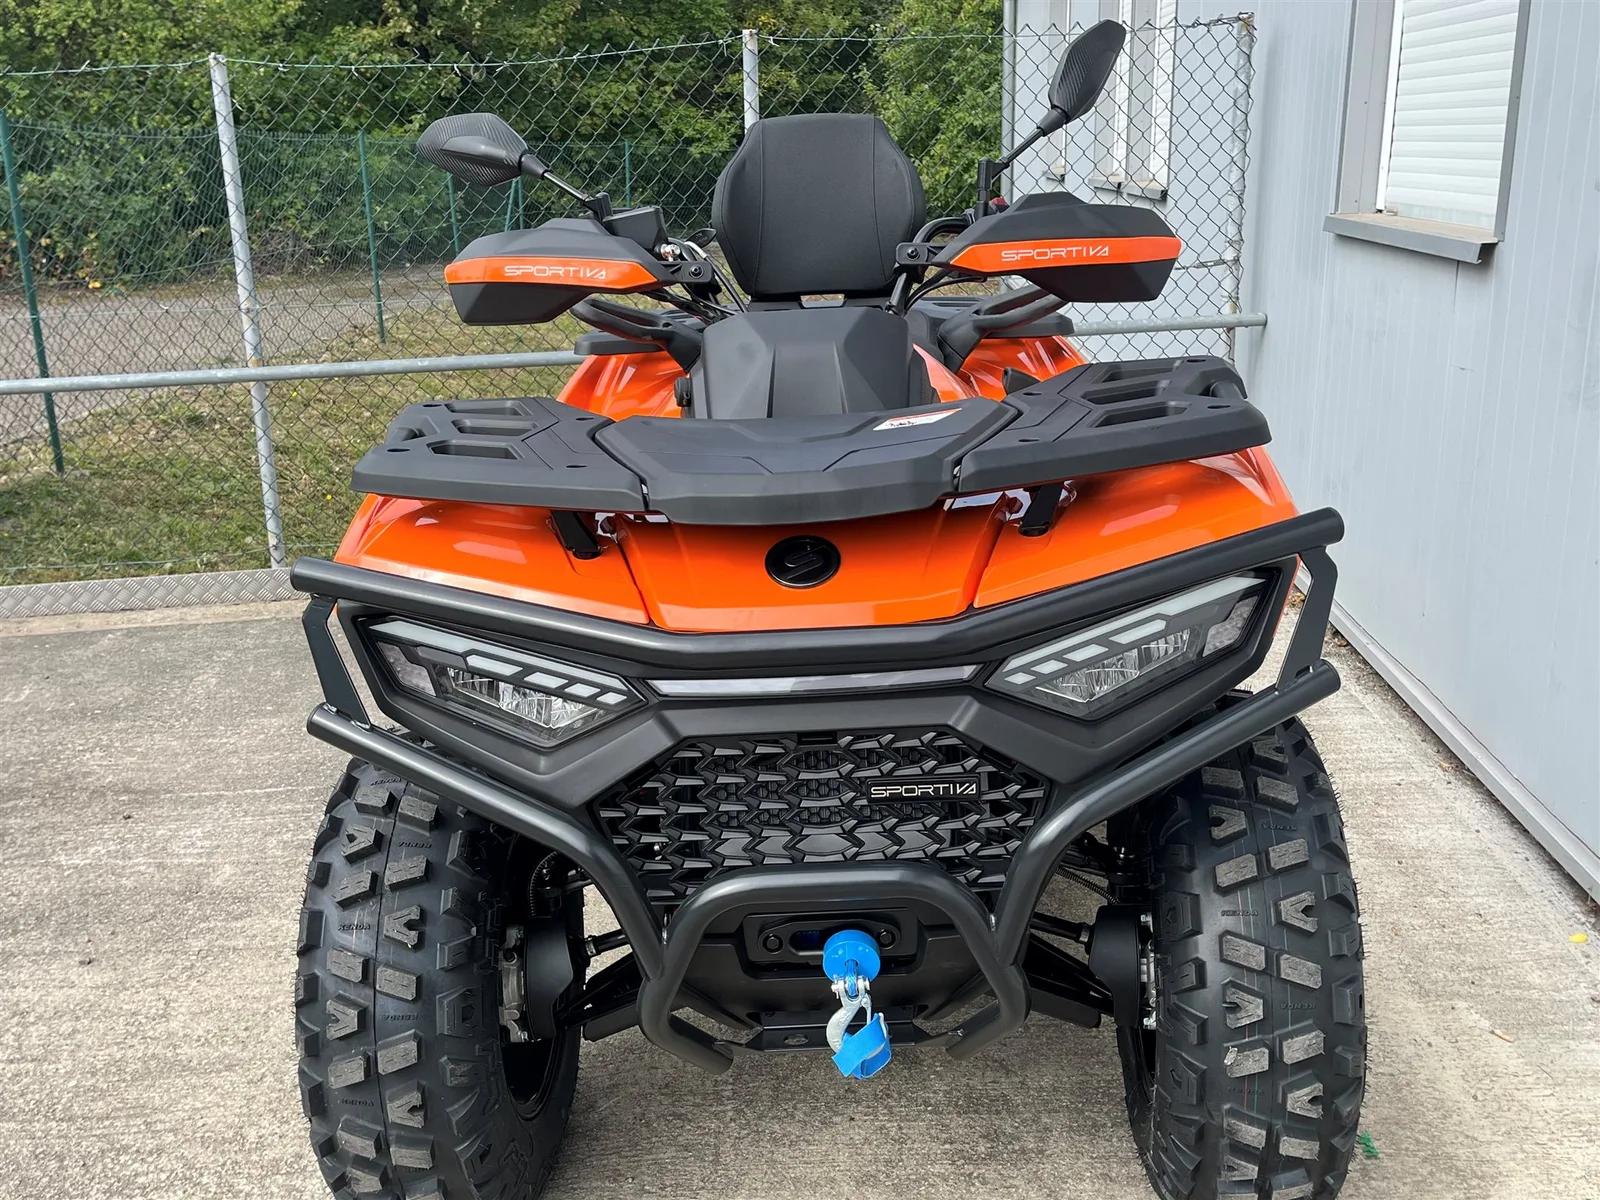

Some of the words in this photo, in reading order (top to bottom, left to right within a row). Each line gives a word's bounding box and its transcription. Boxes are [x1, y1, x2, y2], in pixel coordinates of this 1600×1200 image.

[1001, 245, 1110, 263] SPORTIVA
[504, 265, 607, 280] SPORTIVA
[870, 782, 977, 799] SPORTIVA
[337, 922, 372, 932] KENDA
[1279, 1001, 1317, 1011] KENDA
